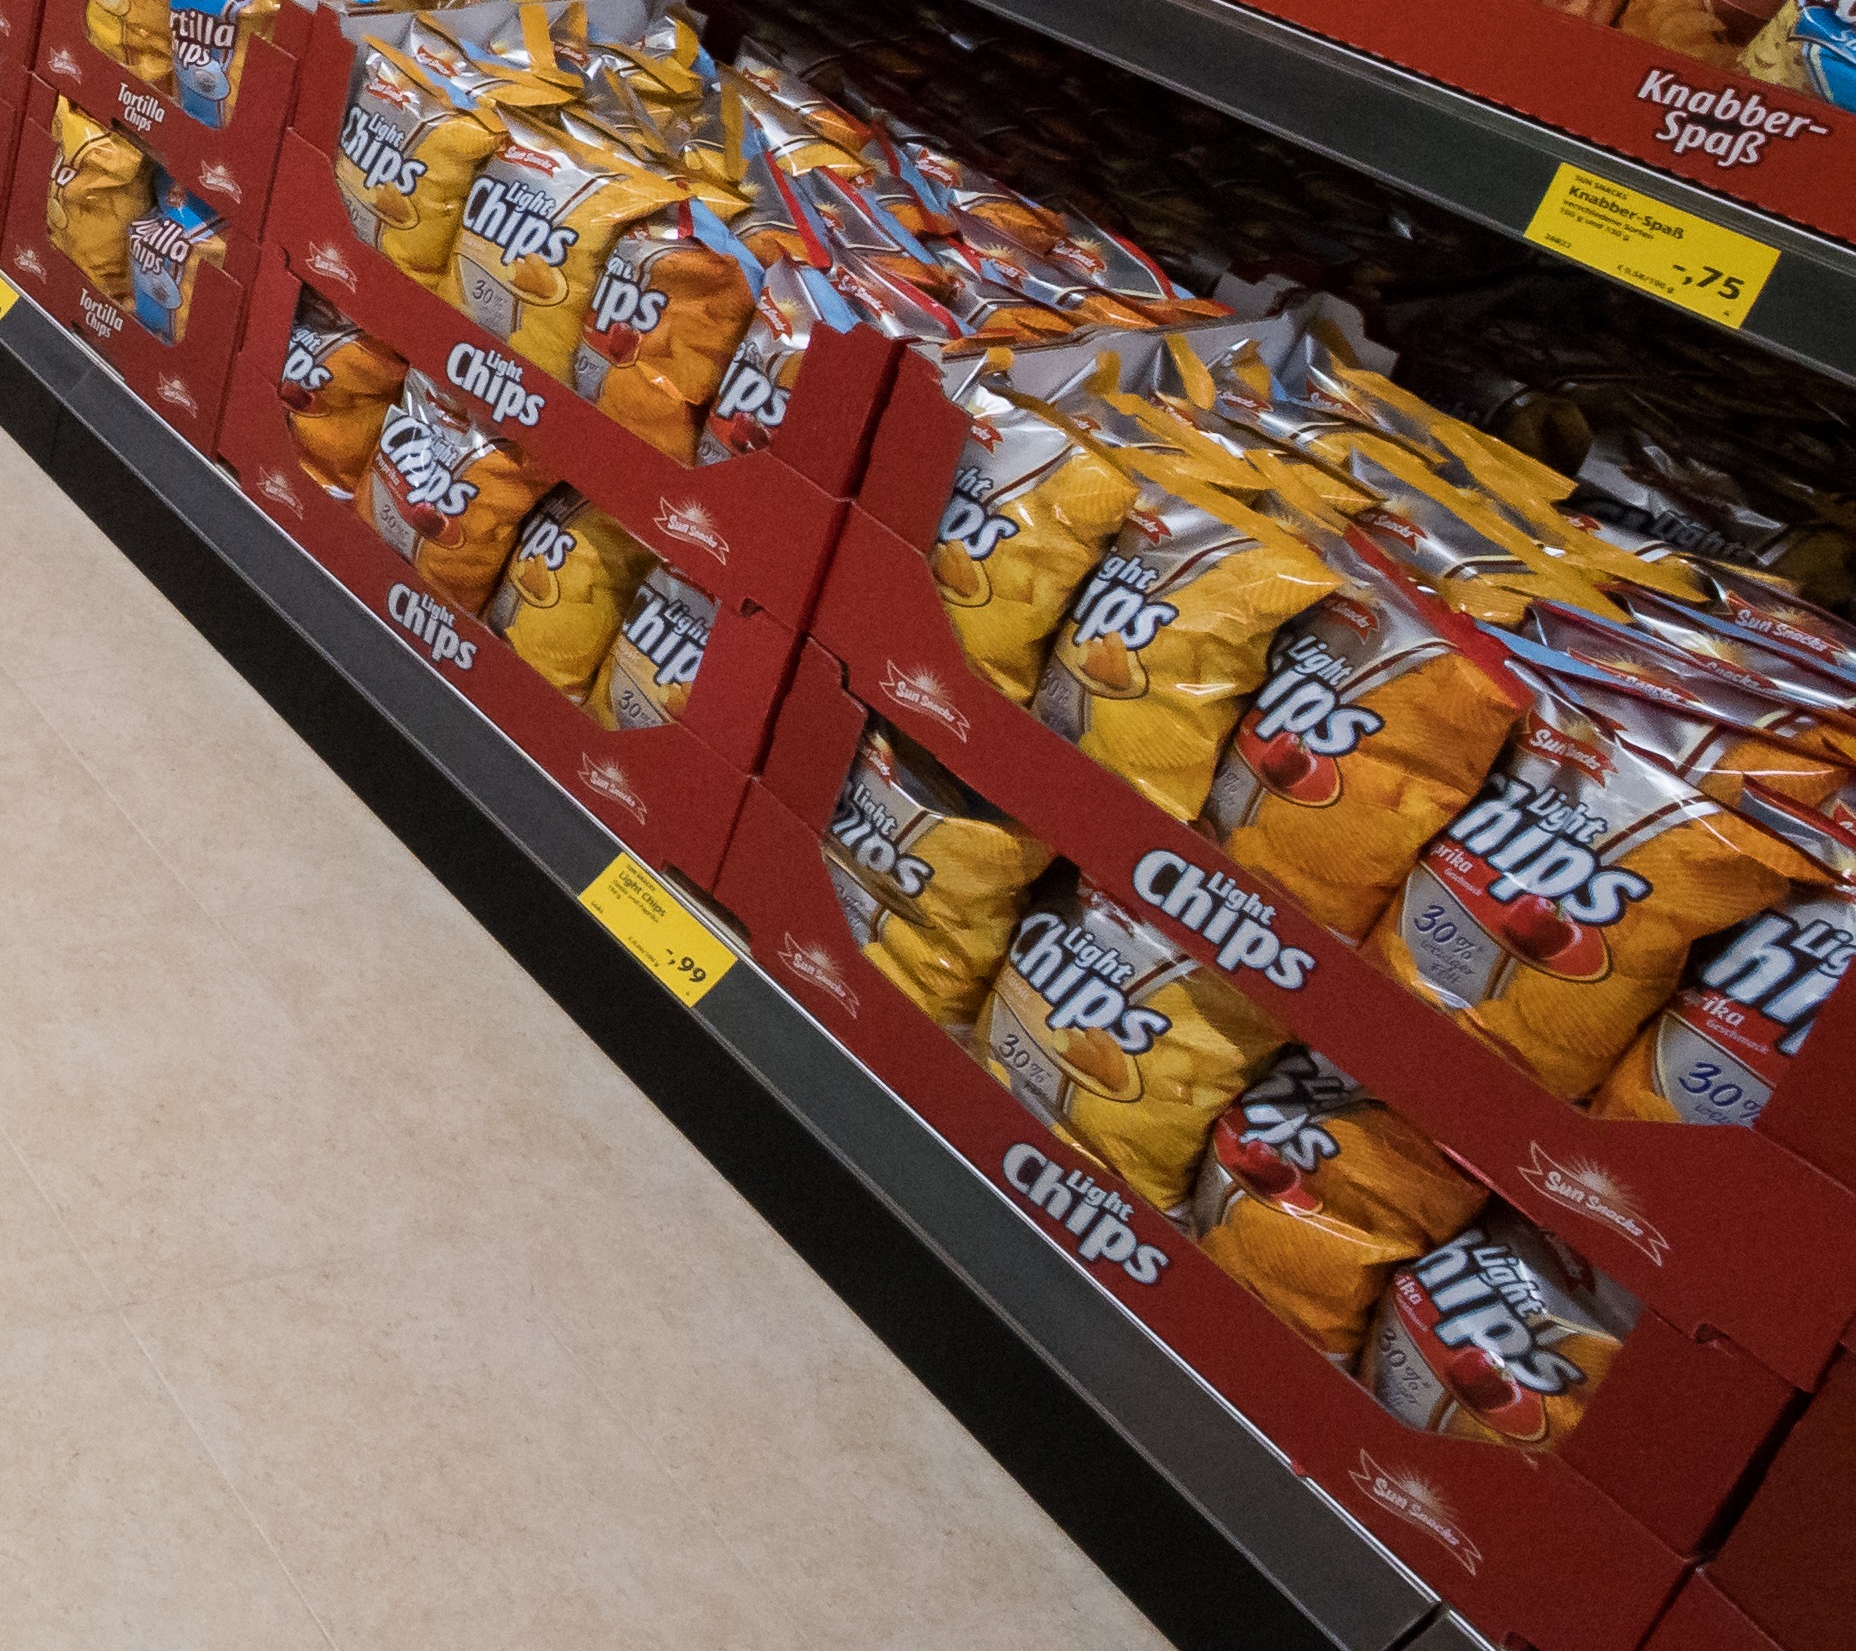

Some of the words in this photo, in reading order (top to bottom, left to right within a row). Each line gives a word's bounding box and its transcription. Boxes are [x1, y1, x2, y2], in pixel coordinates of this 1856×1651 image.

[116, 82, 165, 125] Tortilla
[122, 106, 153, 135] Chips
[1637, 69, 1830, 140] Knabber-
[1656, 110, 1767, 167] Spaß
[461, 172, 579, 266] Chips
[506, 179, 557, 220] Light
[1569, 185, 1684, 240] Knabber-Spaß
[1672, 264, 1745, 301] -,75
[79, 287, 124, 335] Tortilla
[84, 310, 114, 341] Chips
[446, 341, 546, 428] Chips
[487, 348, 524, 386] Light
[387, 582, 478, 673] Chips
[422, 594, 457, 631] Light
[1286, 635, 1353, 687] Light
[1528, 786, 1608, 844] Light
[618, 870, 642, 893] Light
[1208, 869, 1276, 927] Light
[1132, 847, 1317, 994] Chips
[665, 948, 707, 983] -,99
[1006, 909, 1173, 1056] Chips
[1061, 925, 1134, 988] Light
[999, 1141, 1170, 1286] Chips
[1067, 1168, 1135, 1224] Light
[1545, 1171, 1581, 1197] Sun
[1585, 1190, 1646, 1241] Snacks
[1474, 1247, 1545, 1319] Light
[1373, 1475, 1408, 1509] Sun
